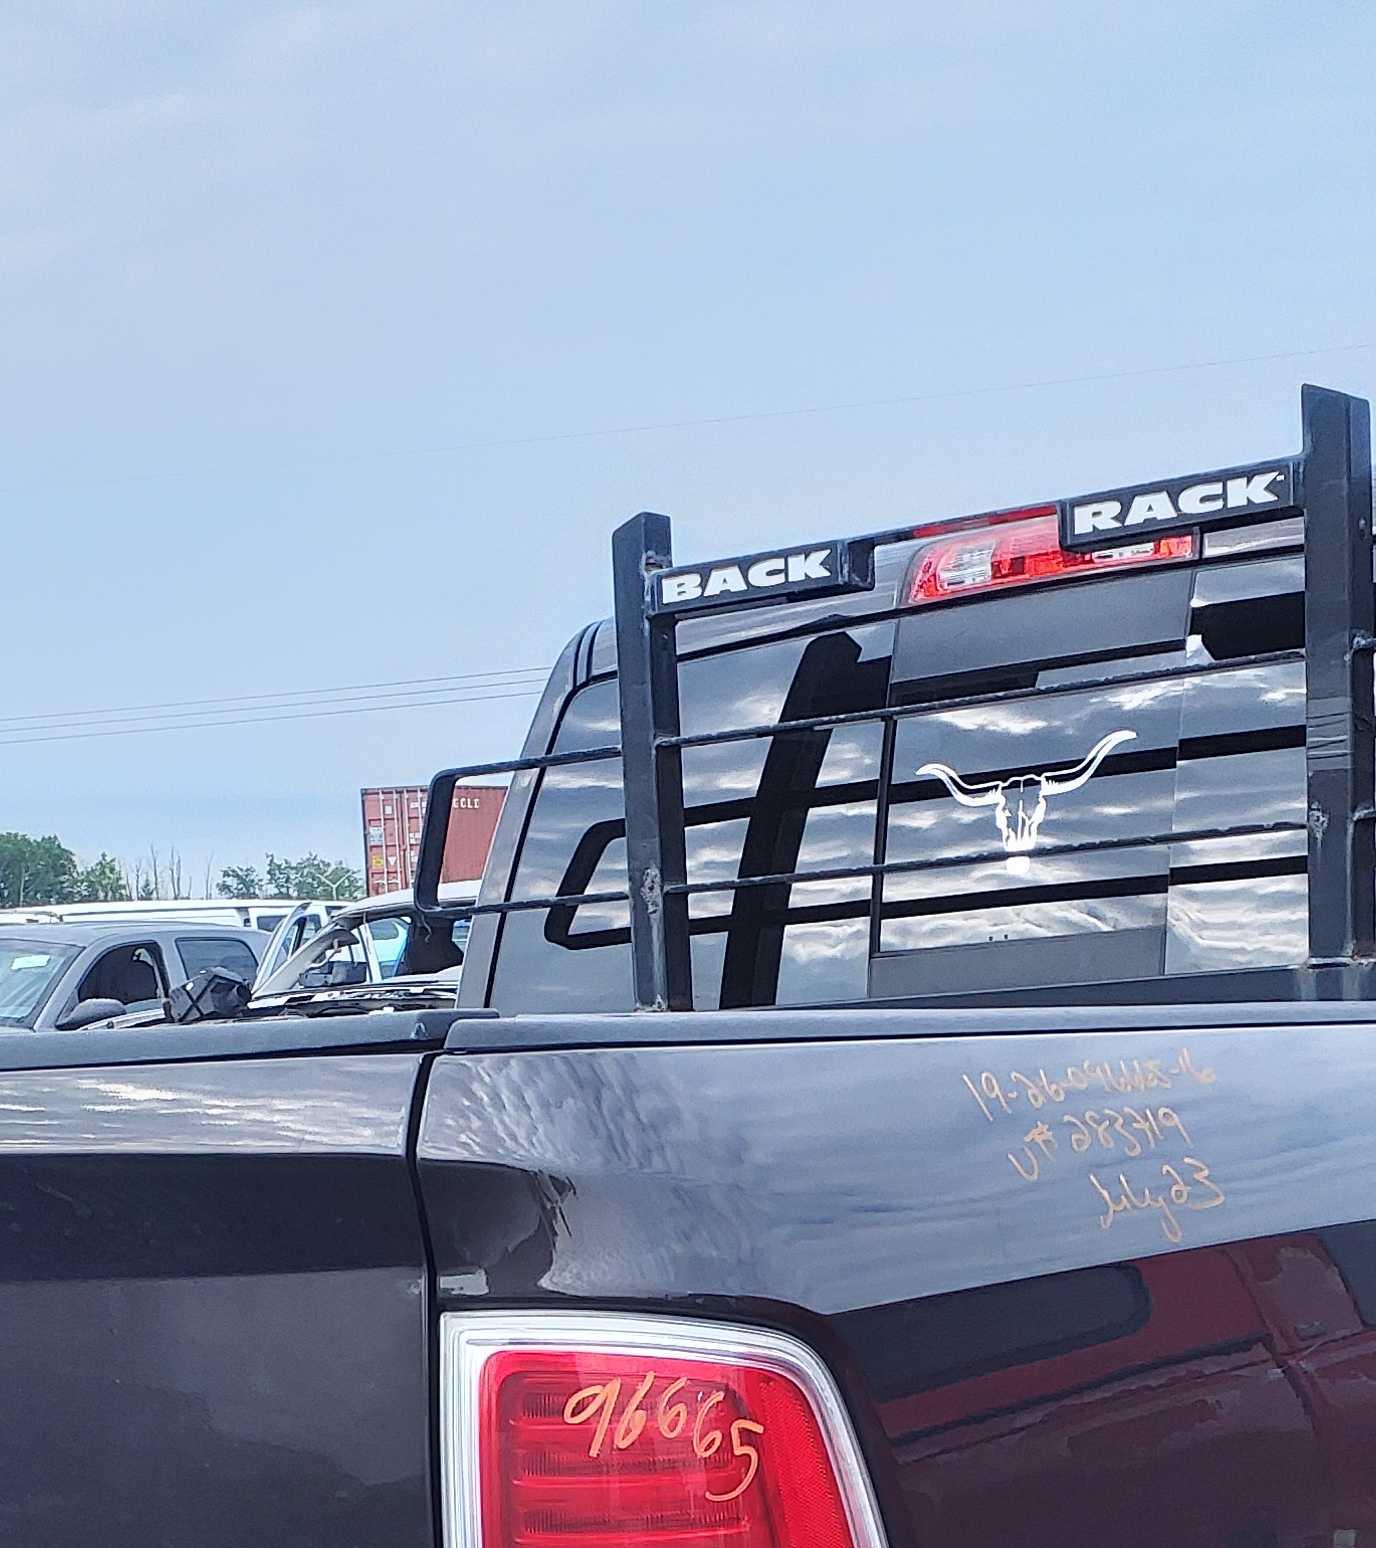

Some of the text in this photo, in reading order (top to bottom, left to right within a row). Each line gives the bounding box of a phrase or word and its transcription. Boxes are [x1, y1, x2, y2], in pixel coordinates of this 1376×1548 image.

[660, 470, 1281, 605] BACK RACK
[561, 1371, 765, 1501] 96665
